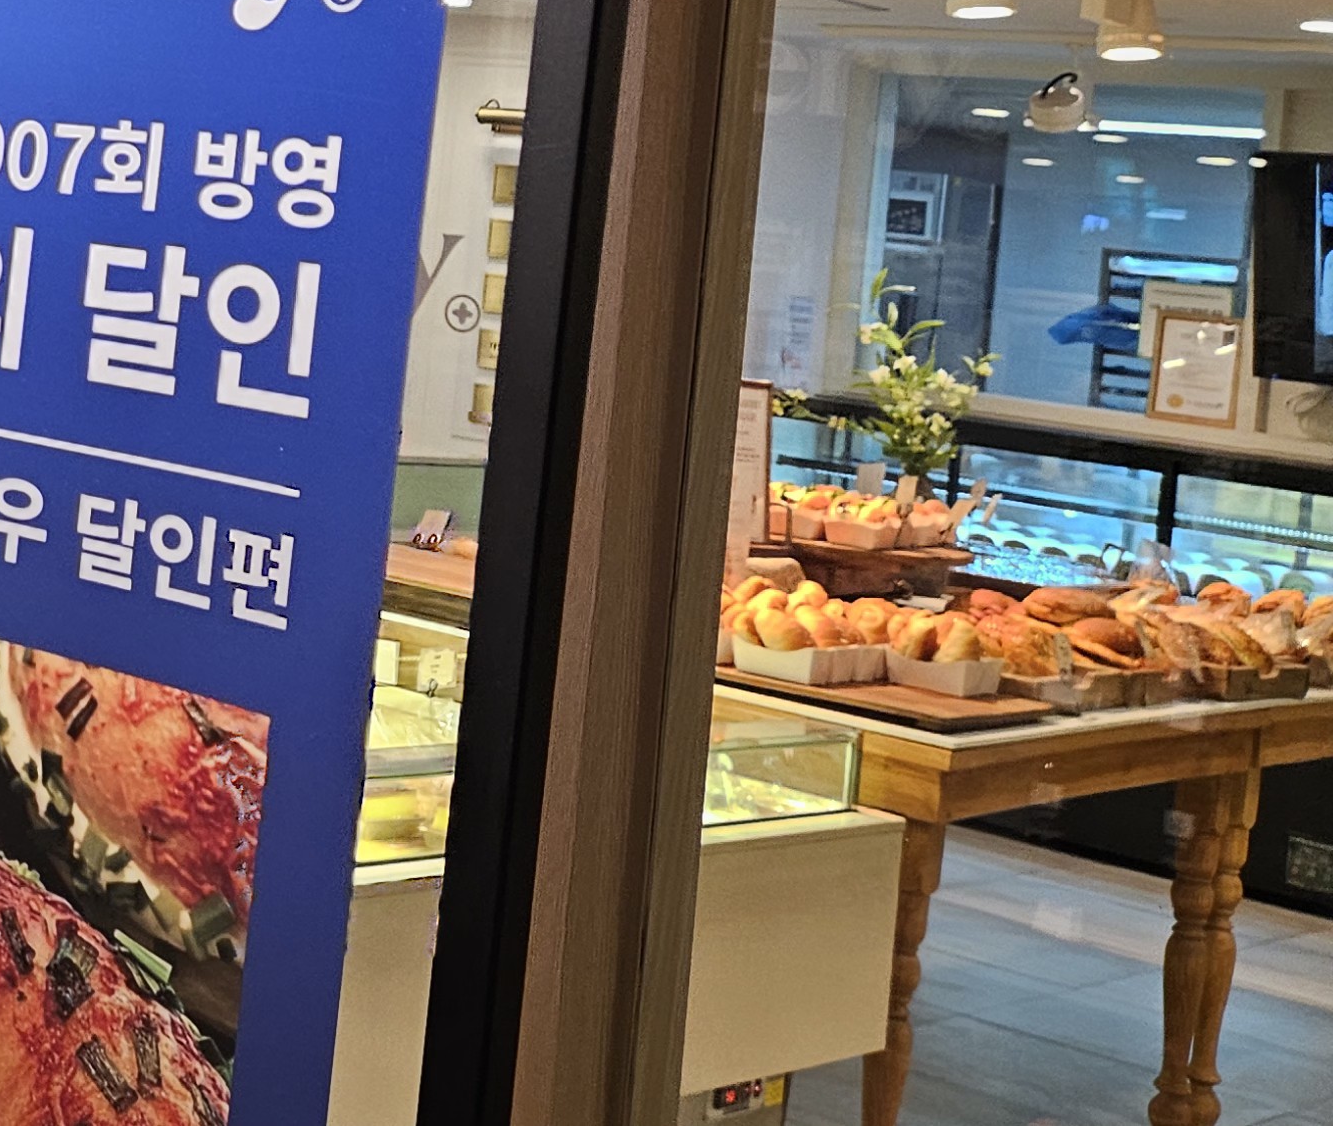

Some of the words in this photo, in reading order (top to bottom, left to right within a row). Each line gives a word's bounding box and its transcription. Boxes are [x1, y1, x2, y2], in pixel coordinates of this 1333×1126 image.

[195, 129, 344, 229] 방영
[83, 245, 322, 420] 달인
[75, 493, 296, 632] 달인편
